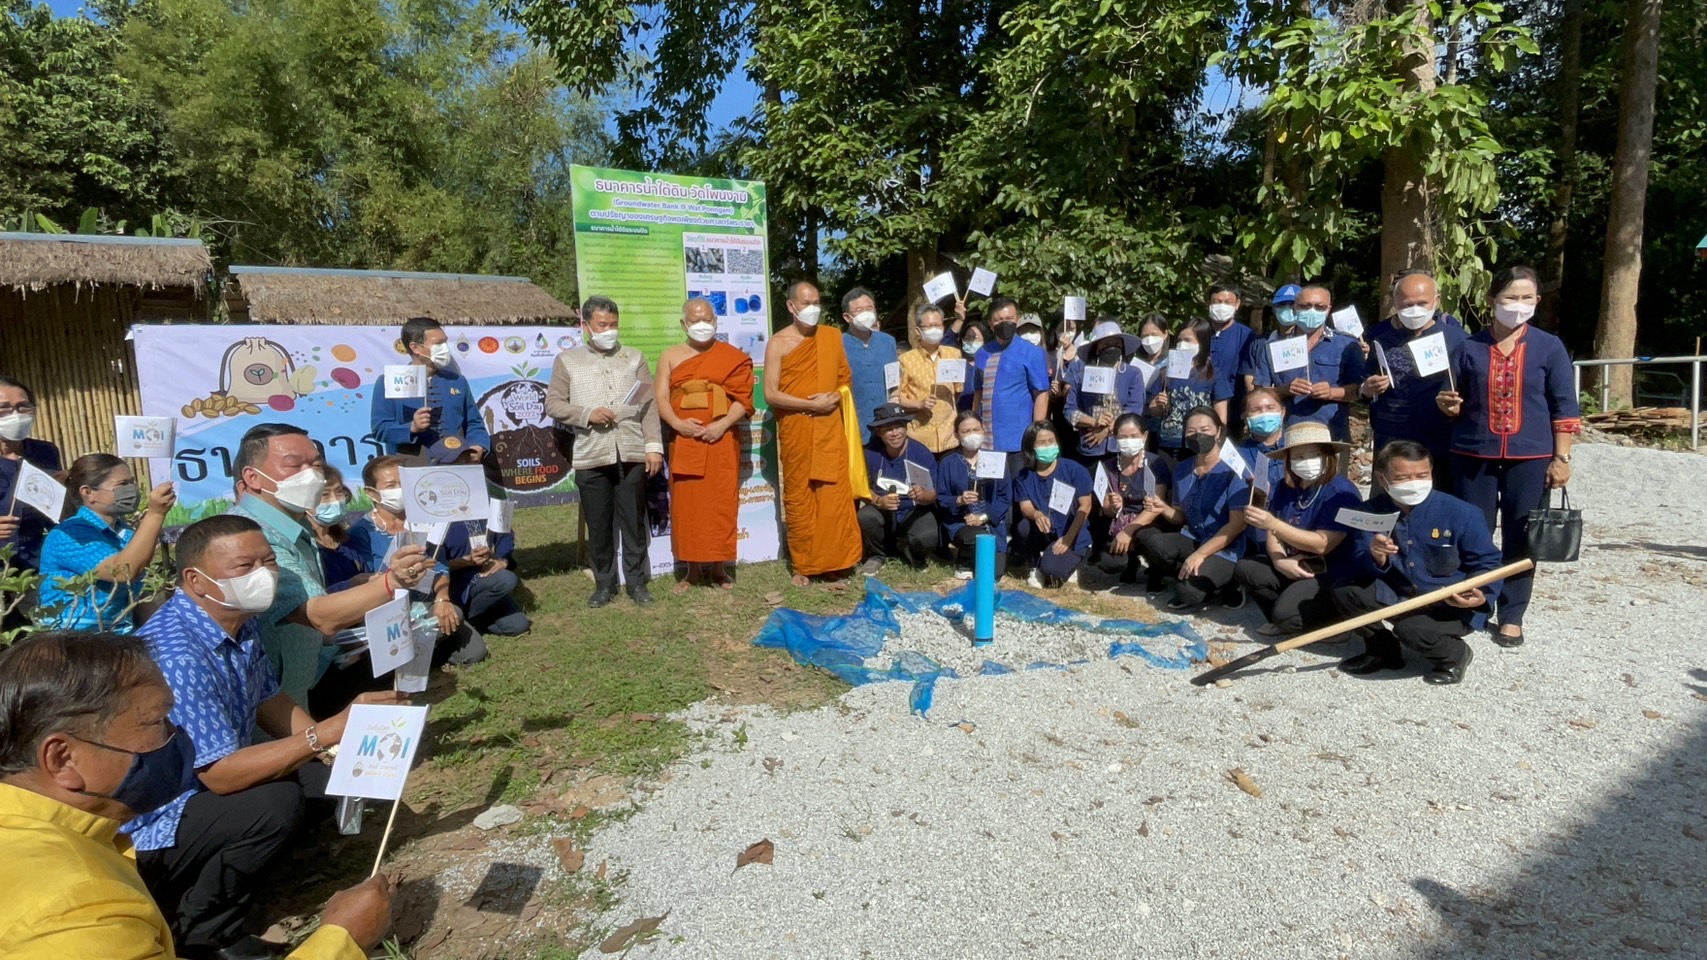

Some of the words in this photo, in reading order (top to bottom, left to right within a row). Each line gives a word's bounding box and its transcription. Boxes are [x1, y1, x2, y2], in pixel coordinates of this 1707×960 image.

[596, 177, 688, 197] ธนาคารน้ำใต้ดิน
[691, 184, 747, 202] วัดโพนงาม
[614, 198, 660, 208] (Groundwater
[512, 391, 538, 401] World
[509, 402, 525, 411] Soil
[526, 402, 543, 413] Day
[501, 467, 534, 477] WHERE
[535, 465, 559, 475] FOOD
[515, 474, 547, 485] BEGINS
[356, 732, 412, 763] MOI
